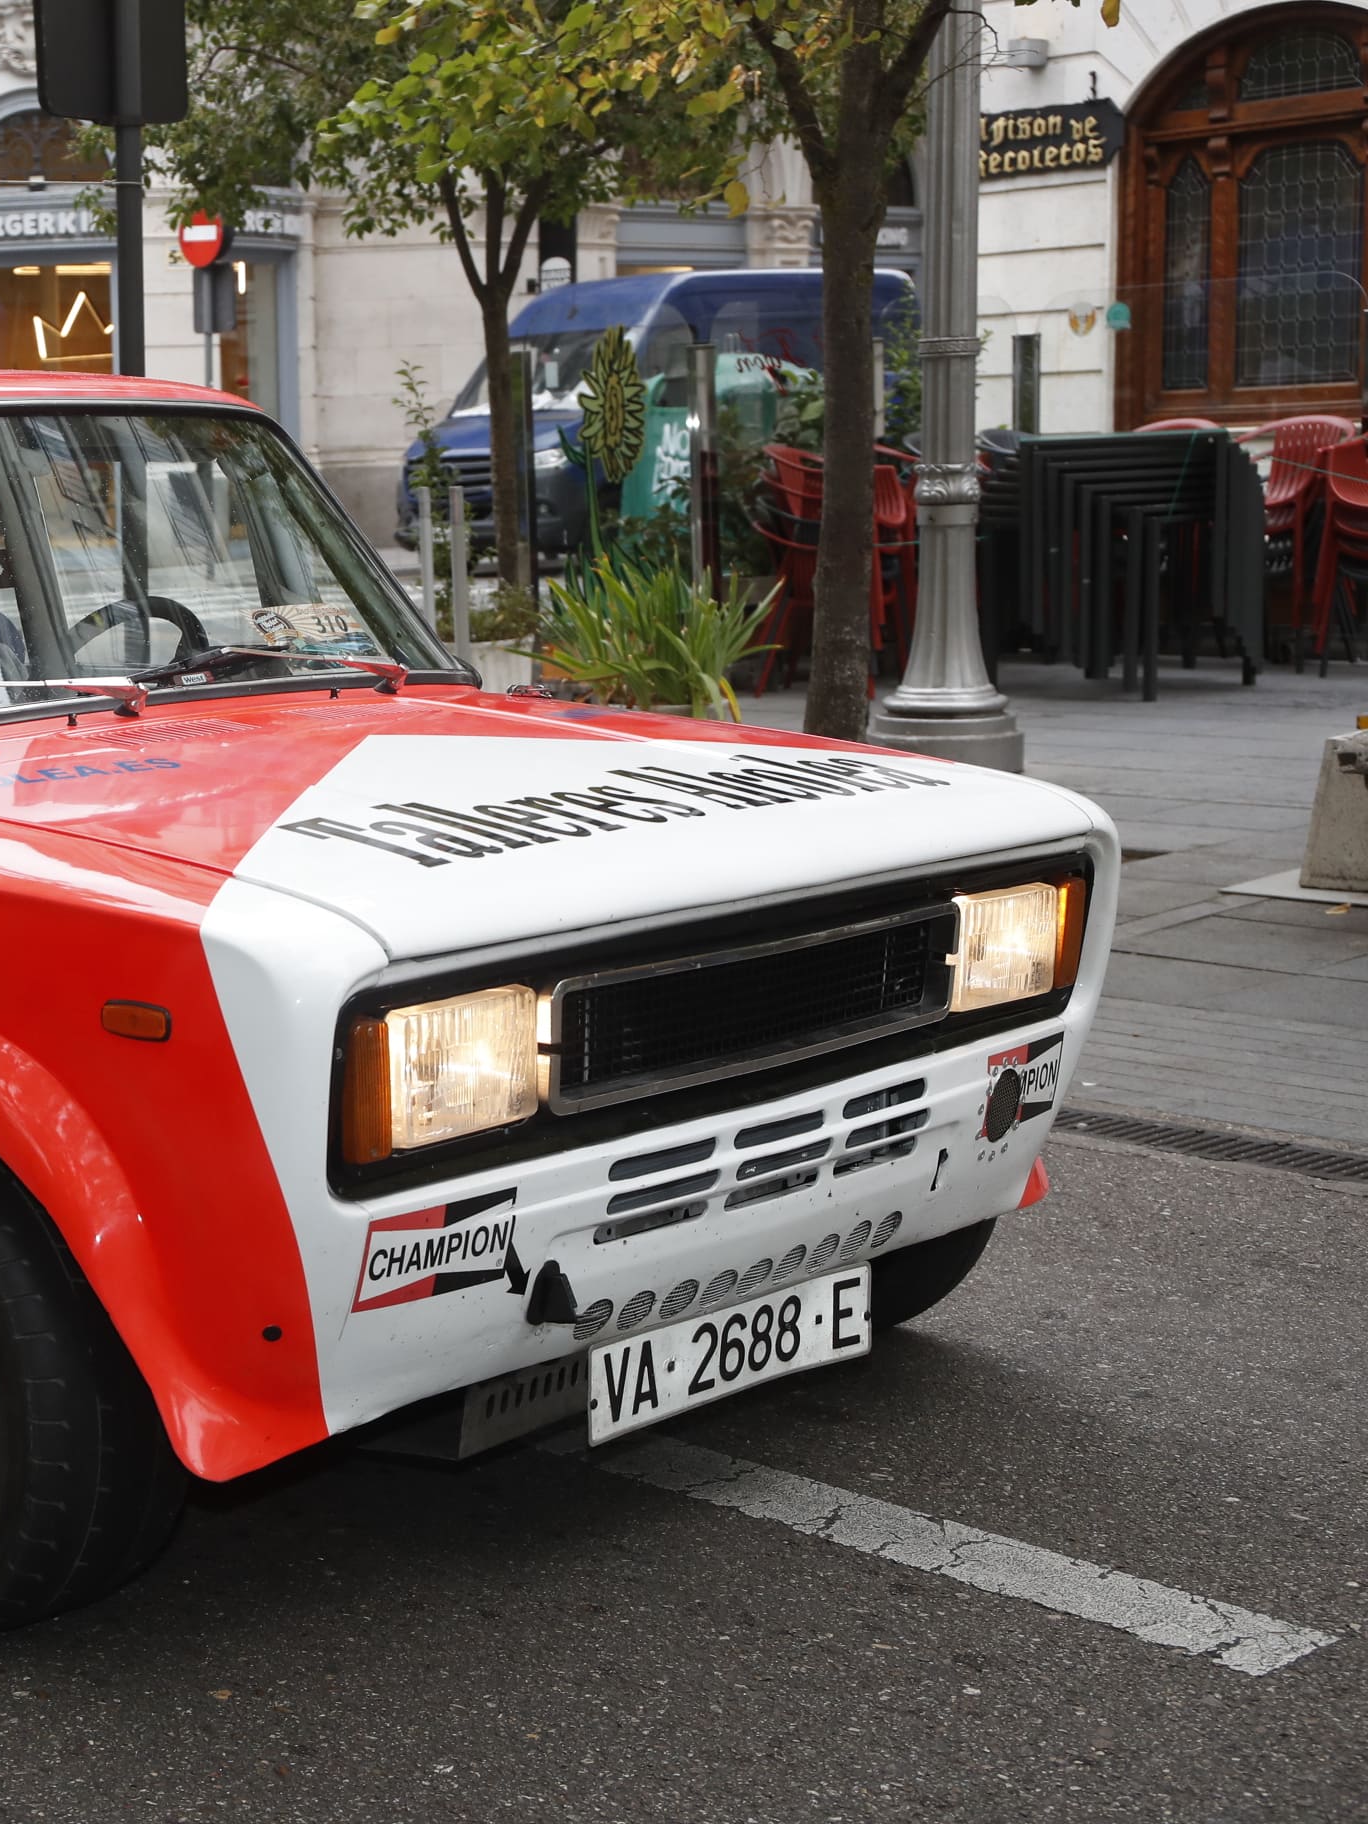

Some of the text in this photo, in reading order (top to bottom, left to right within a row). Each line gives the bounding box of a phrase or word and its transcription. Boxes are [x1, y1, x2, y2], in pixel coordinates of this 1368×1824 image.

[1069, 115, 1100, 141] de
[312, 614, 348, 633] 310
[277, 754, 951, 868] Talleres Alcolea
[1020, 1059, 1059, 1096] PION
[368, 1220, 510, 1282] CHAMPION
[603, 1276, 861, 1423] VA 2688 E
